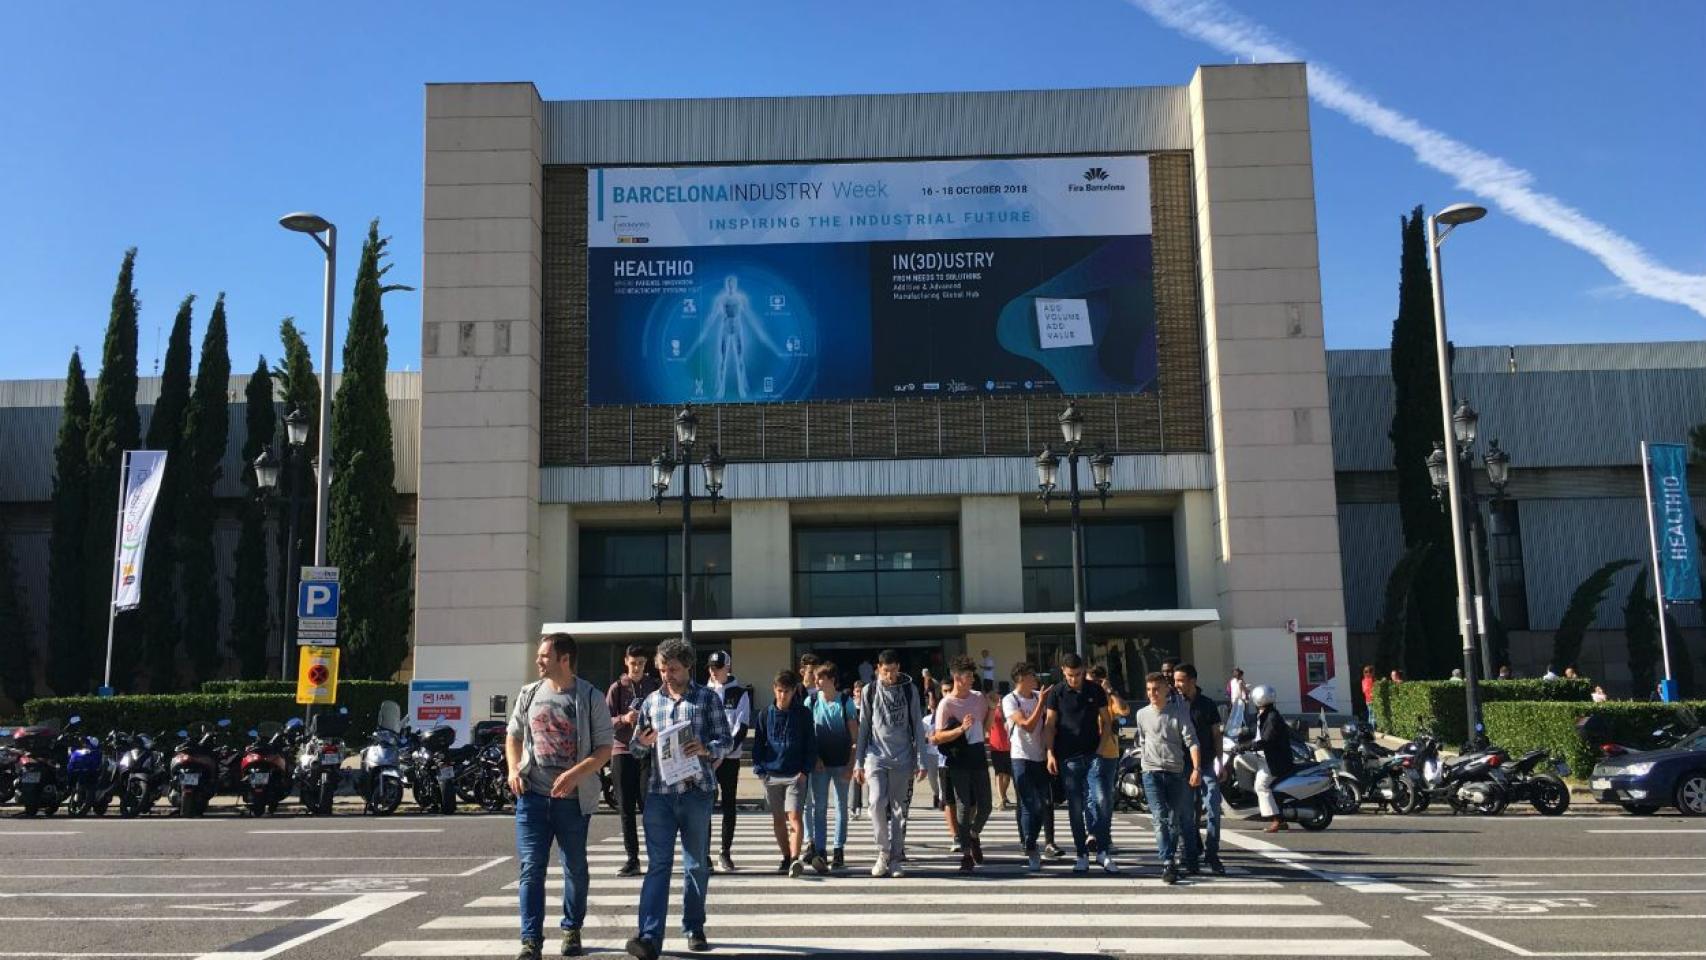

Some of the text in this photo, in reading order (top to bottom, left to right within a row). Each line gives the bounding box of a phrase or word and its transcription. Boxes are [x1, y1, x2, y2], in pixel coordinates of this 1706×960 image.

[832, 180, 888, 199] Week
[942, 186, 954, 195] 18
[956, 185, 1001, 195] OCTOBER
[1003, 184, 1028, 194] 2018
[1068, 183, 1126, 192] Fira Barcelona
[709, 210, 1032, 231] INSPIRING THE INDUSTRIAL FUTURE
[892, 252, 995, 272] IN(3D)USTRY
[614, 260, 694, 277] HEALTHIO
[945, 272, 982, 280] SOLUTIONS
[1043, 304, 1063, 312] ADD
[1045, 312, 1081, 321] VOLUME
[1046, 322, 1065, 331] ADD
[1047, 331, 1076, 340] VALUE
[1663, 475, 1688, 560] HEALTHIO
[306, 585, 331, 615] P
